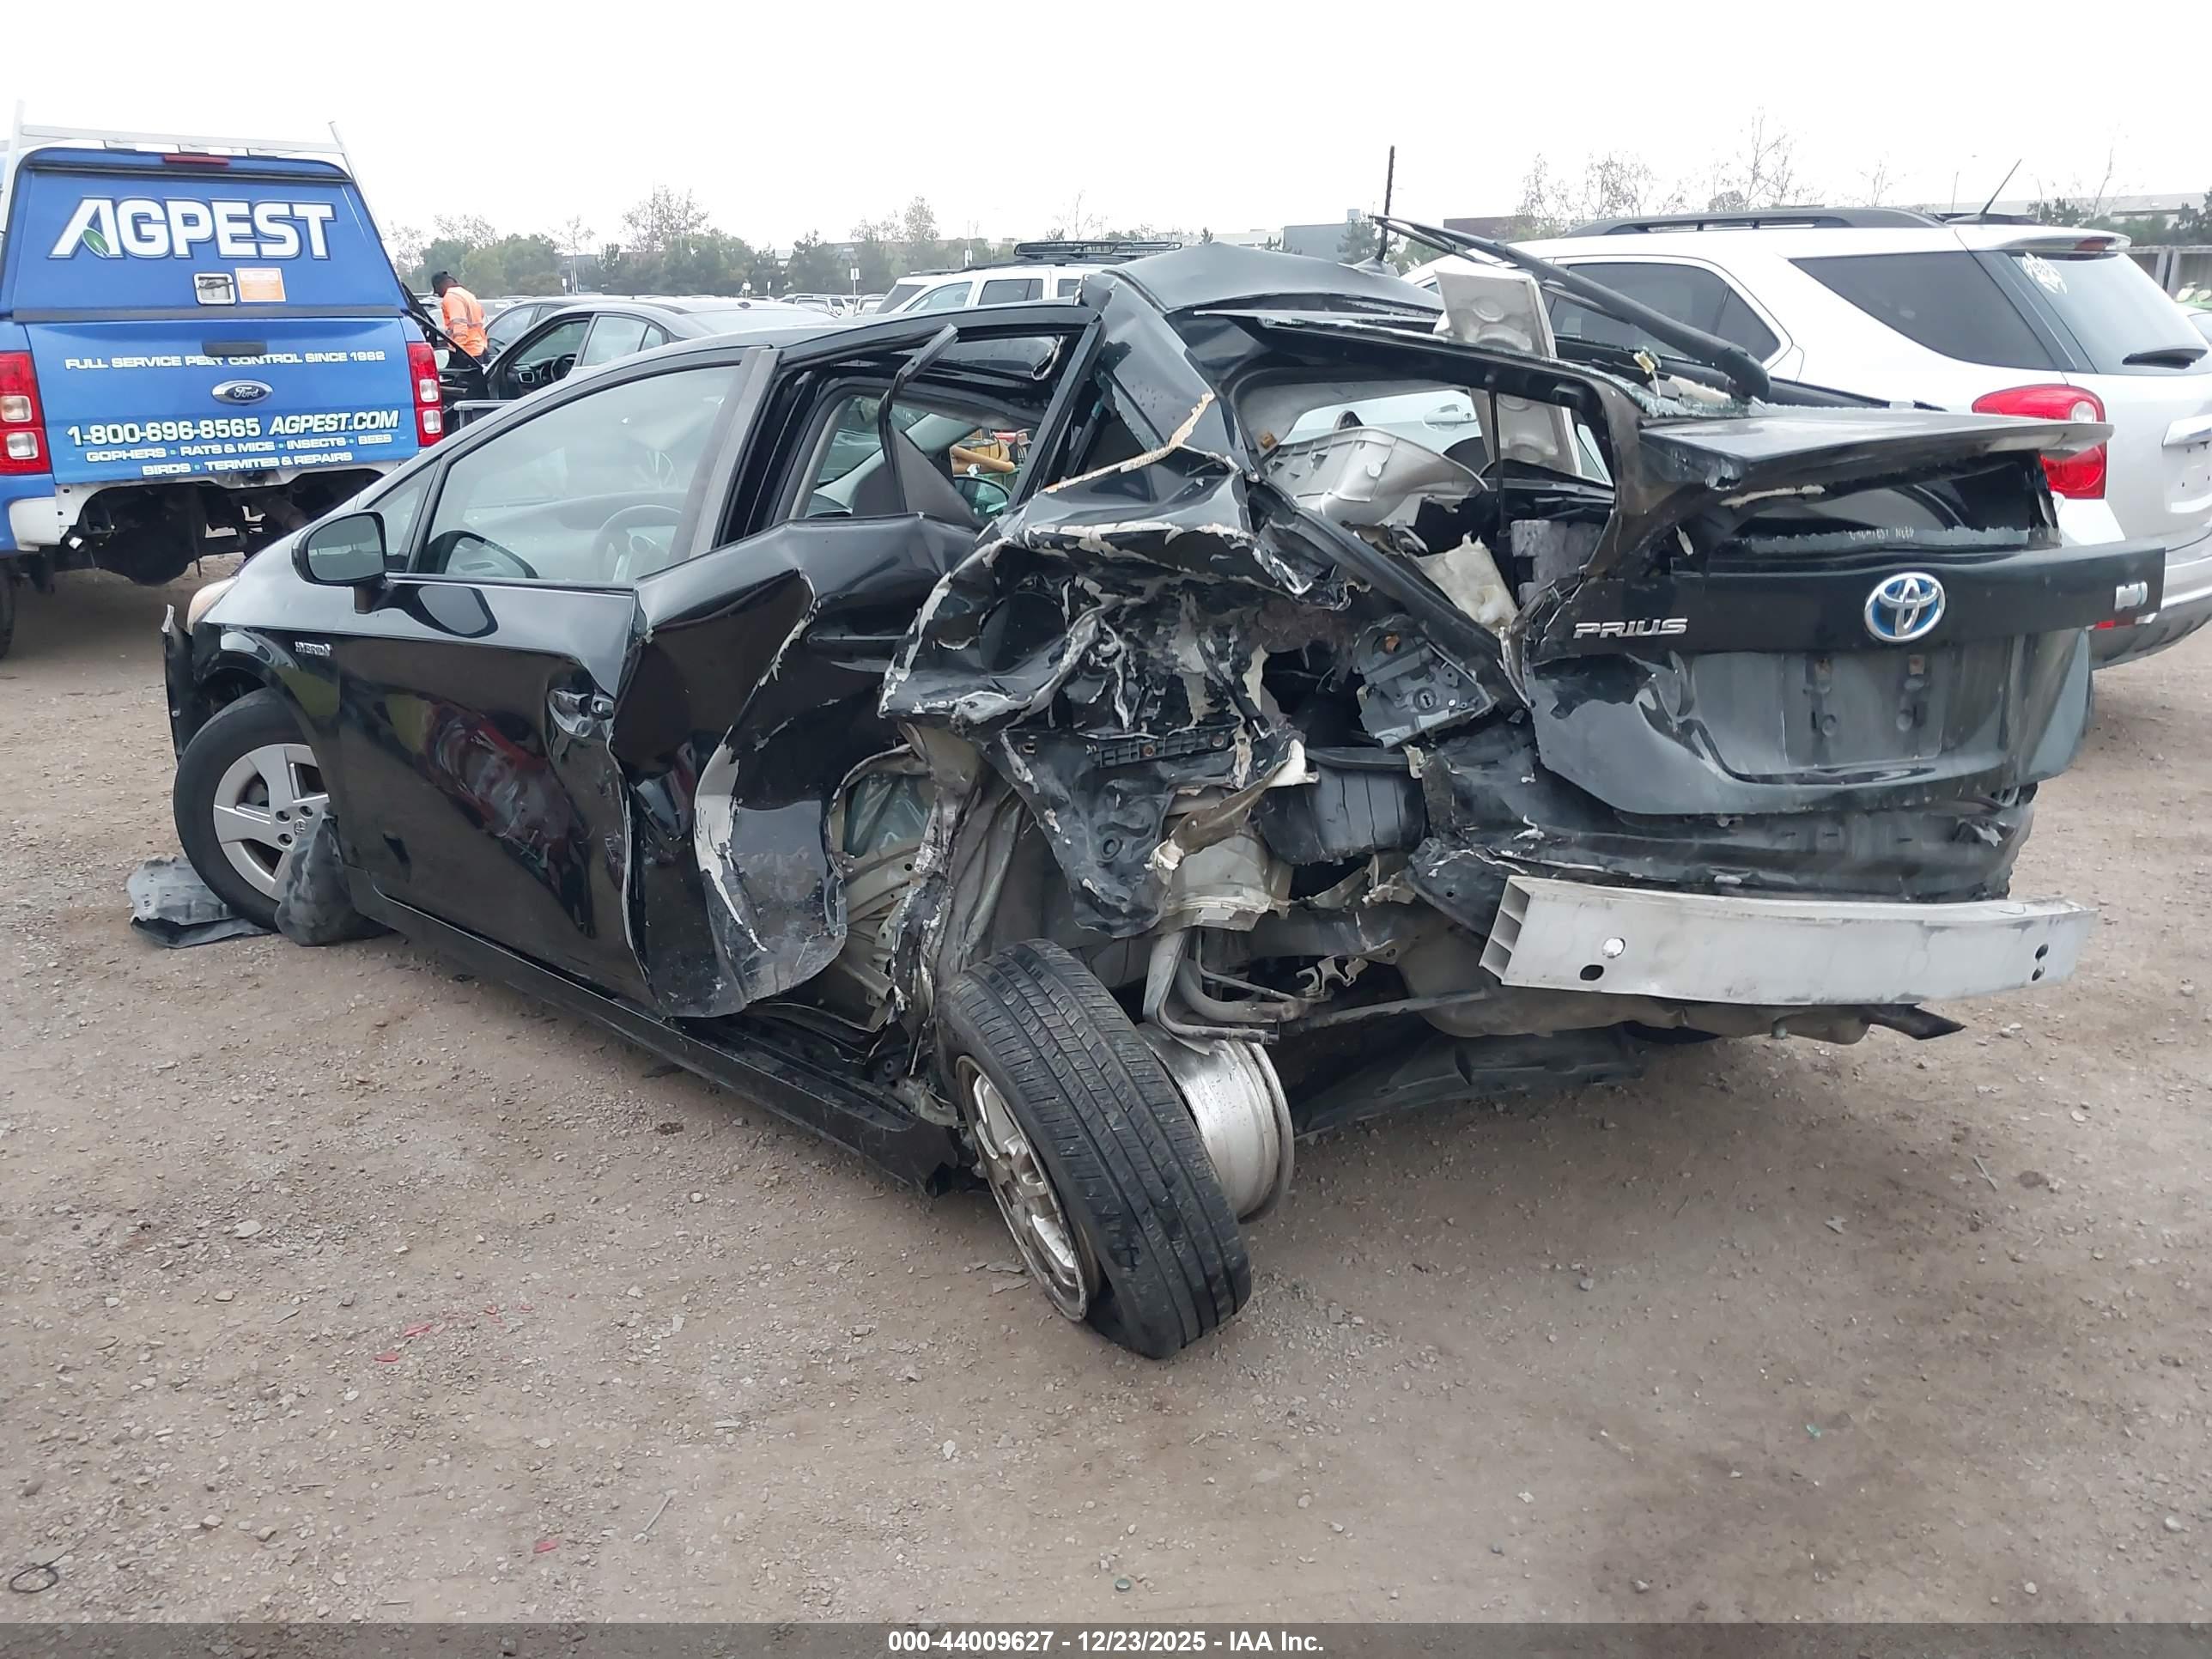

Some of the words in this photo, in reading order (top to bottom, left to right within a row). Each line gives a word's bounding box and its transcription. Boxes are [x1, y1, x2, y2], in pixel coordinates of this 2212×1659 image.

[47, 197, 336, 260] AGPEST
[64, 357, 109, 370] FULL
[111, 356, 182, 368] SERVICE
[184, 355, 223, 367] PEST
[228, 353, 303, 367] CONTROL
[305, 351, 348, 364] SINCE
[234, 386, 259, 398] Ford
[67, 418, 260, 447] 1-800-696-8565
[268, 410, 400, 436] AGPEST.COM
[86, 447, 167, 462] GOPHERS
[180, 444, 222, 457] RATS
[223, 443, 236, 454] &
[238, 441, 276, 453] MICE
[286, 437, 347, 451] INSECTS
[357, 434, 392, 446] BEES
[142, 463, 191, 476] BIRDS
[204, 457, 280, 471] TERMITES
[281, 456, 293, 467] &
[294, 452, 353, 465] REPAIRS
[1572, 617, 1688, 639] PRIUS
